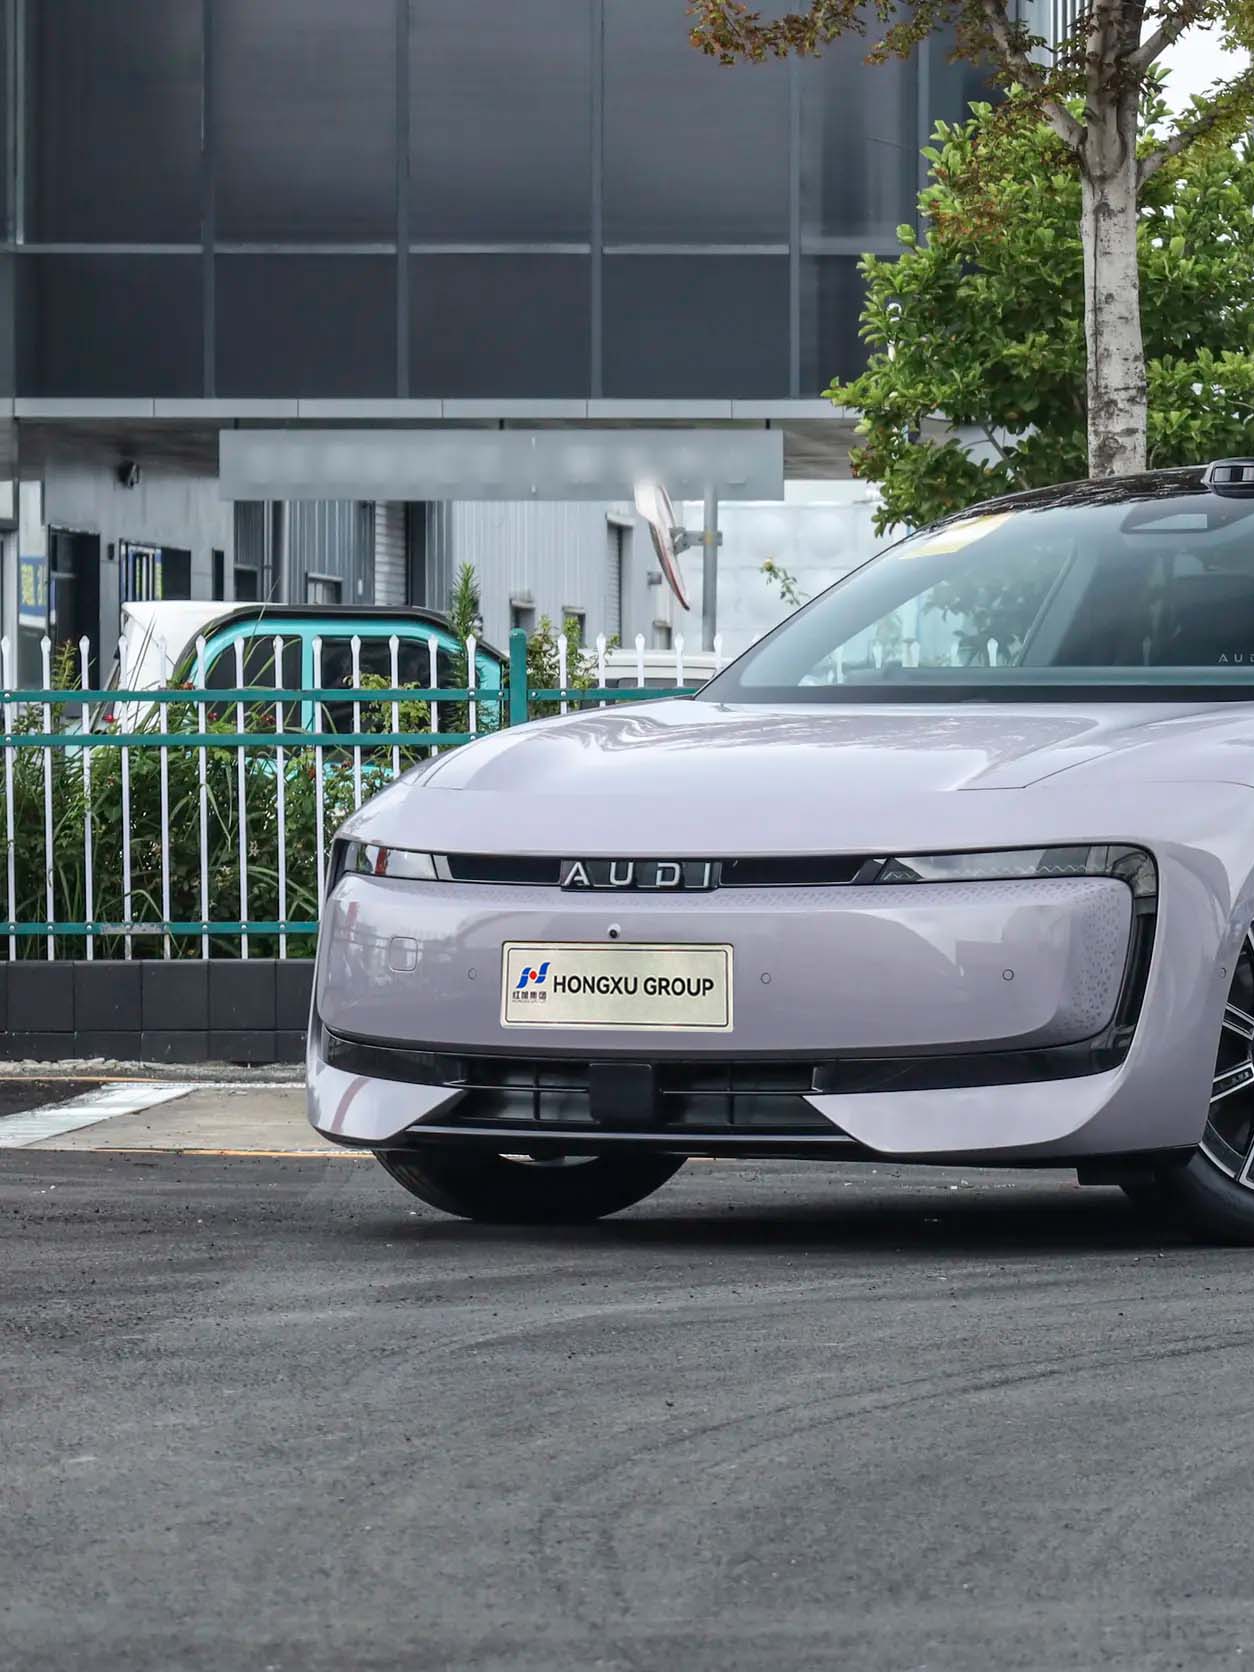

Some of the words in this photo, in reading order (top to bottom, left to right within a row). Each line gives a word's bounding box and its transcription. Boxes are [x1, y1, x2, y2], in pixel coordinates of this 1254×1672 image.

[563, 862, 711, 887] AUDI
[553, 976, 638, 995] HONGXU
[644, 977, 714, 997] GROUP
